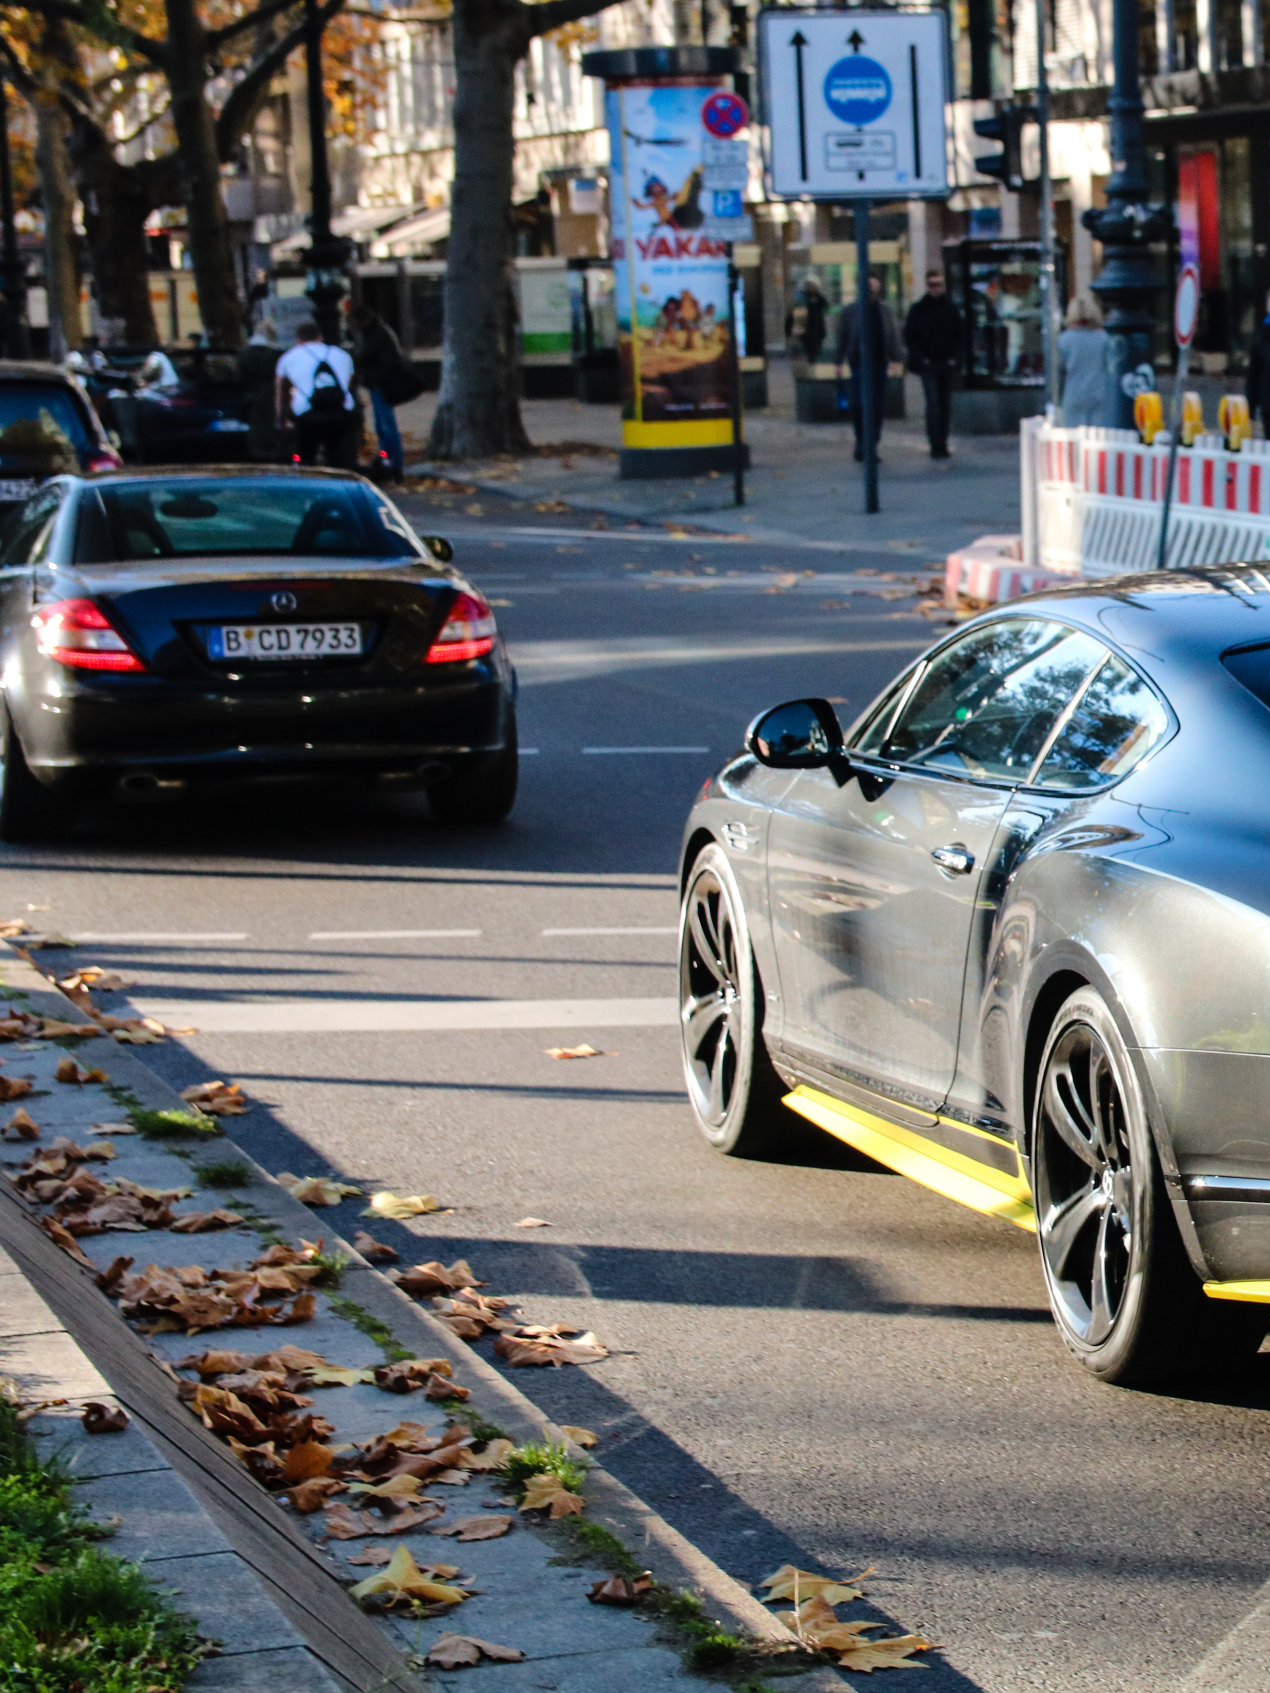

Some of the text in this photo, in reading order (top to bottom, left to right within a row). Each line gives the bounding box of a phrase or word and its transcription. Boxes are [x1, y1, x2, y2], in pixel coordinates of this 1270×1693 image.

[225, 631, 241, 651] B
[258, 629, 290, 650] CD
[296, 627, 357, 650] 7933
